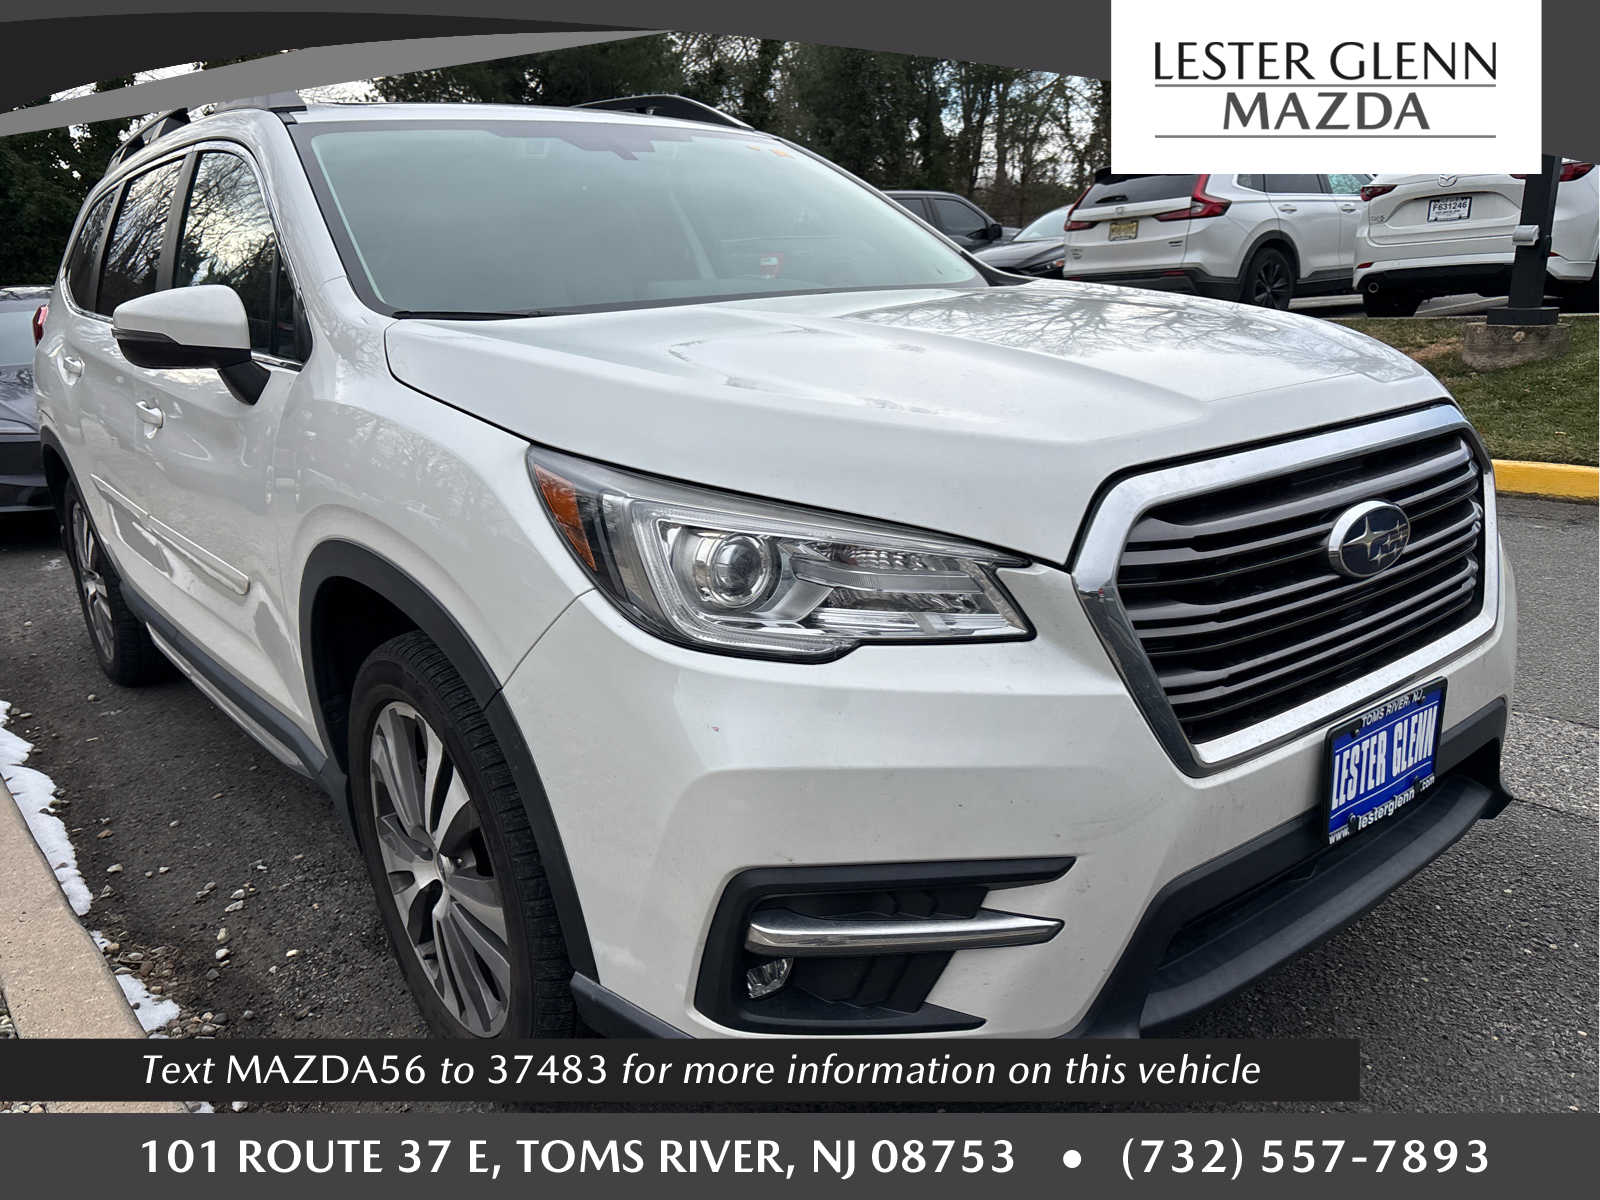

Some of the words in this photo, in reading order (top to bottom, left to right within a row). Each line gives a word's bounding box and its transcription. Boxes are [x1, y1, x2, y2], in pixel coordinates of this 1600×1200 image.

[1361, 707, 1385, 728] TOMS
[1331, 730, 1387, 810] LESTER
[1392, 705, 1438, 777] GLENN
